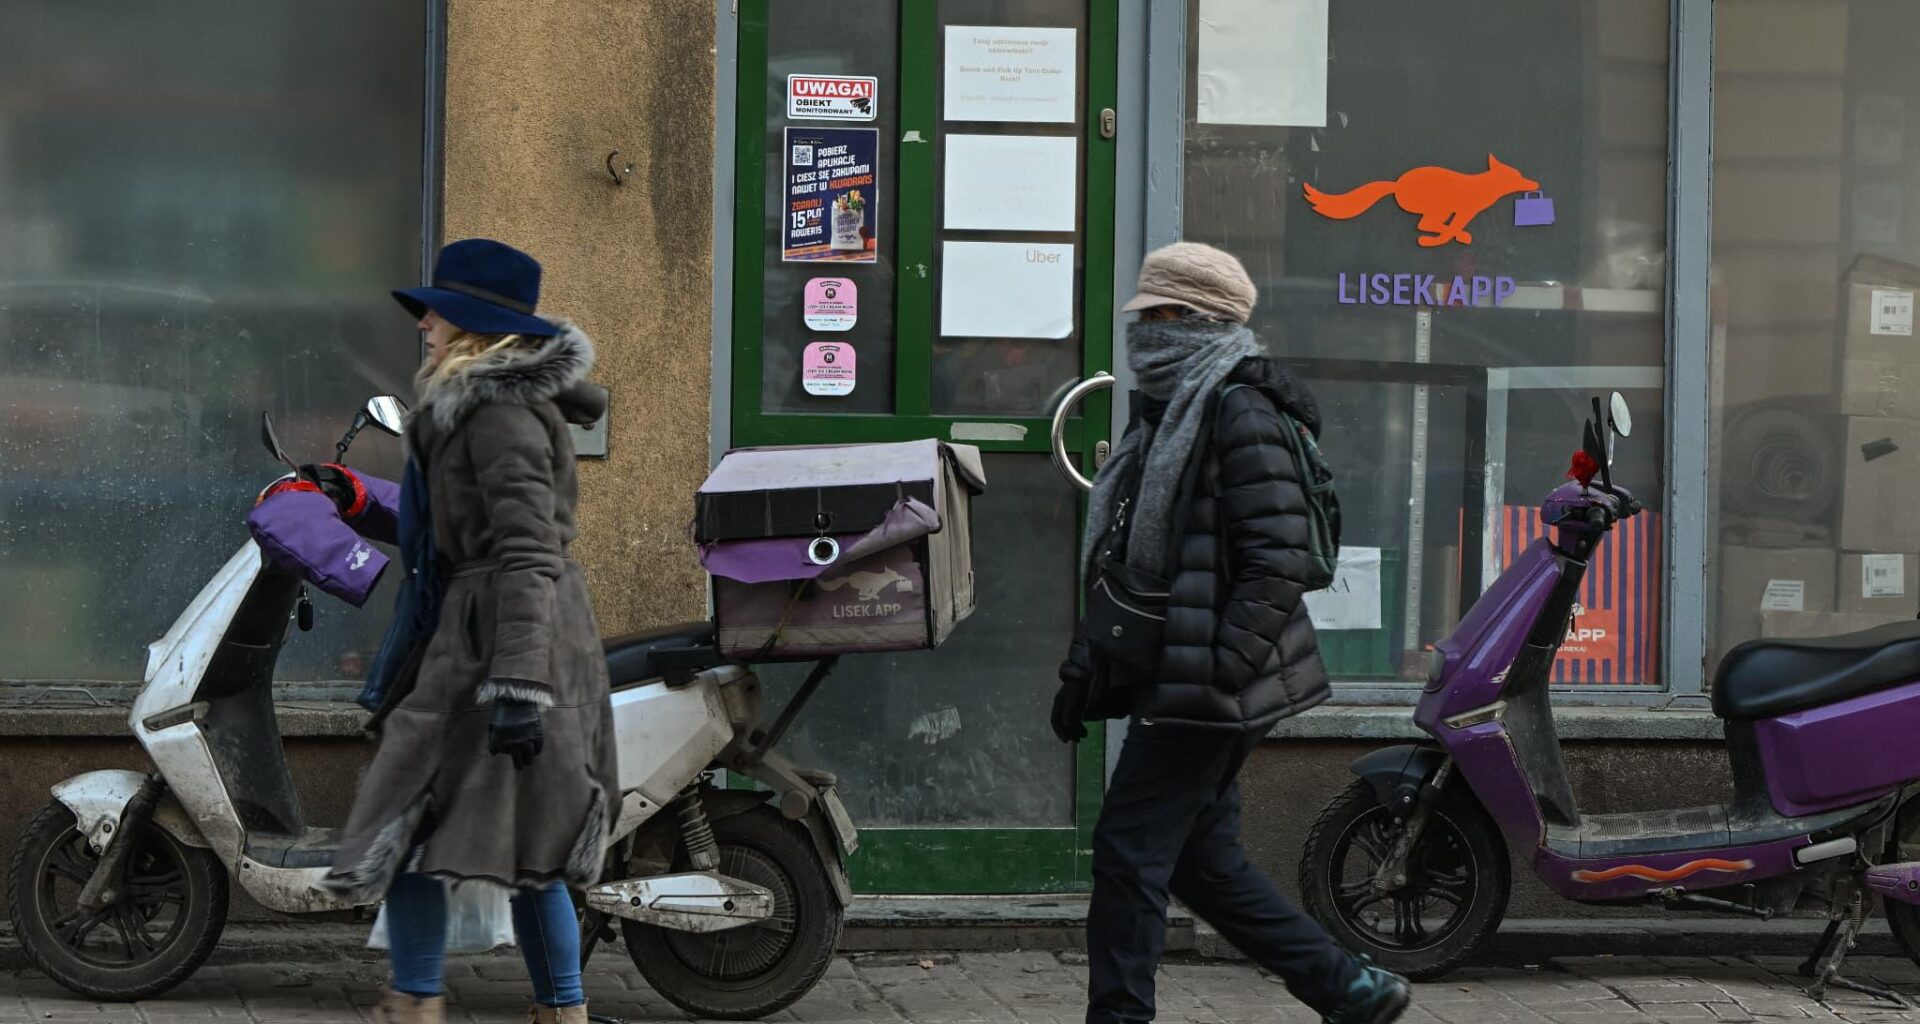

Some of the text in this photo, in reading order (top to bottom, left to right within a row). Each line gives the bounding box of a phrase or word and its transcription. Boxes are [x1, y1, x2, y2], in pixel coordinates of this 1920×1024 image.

[796, 81, 869, 97] UWAGA!
[796, 98, 832, 107] OBIEKT
[796, 107, 854, 115] MONITOROWANY
[818, 145, 848, 158] POBIERZ
[818, 154, 856, 168] APLIKACJĘ
[791, 164, 870, 184] I CIESZ SIĘ ZAKUPAMI
[791, 174, 873, 195] NAWET W KWADRANS
[792, 198, 822, 211] ZGARNIJ
[791, 210, 806, 229] 15
[791, 225, 823, 238] ROWER15
[1026, 249, 1061, 263] Uber
